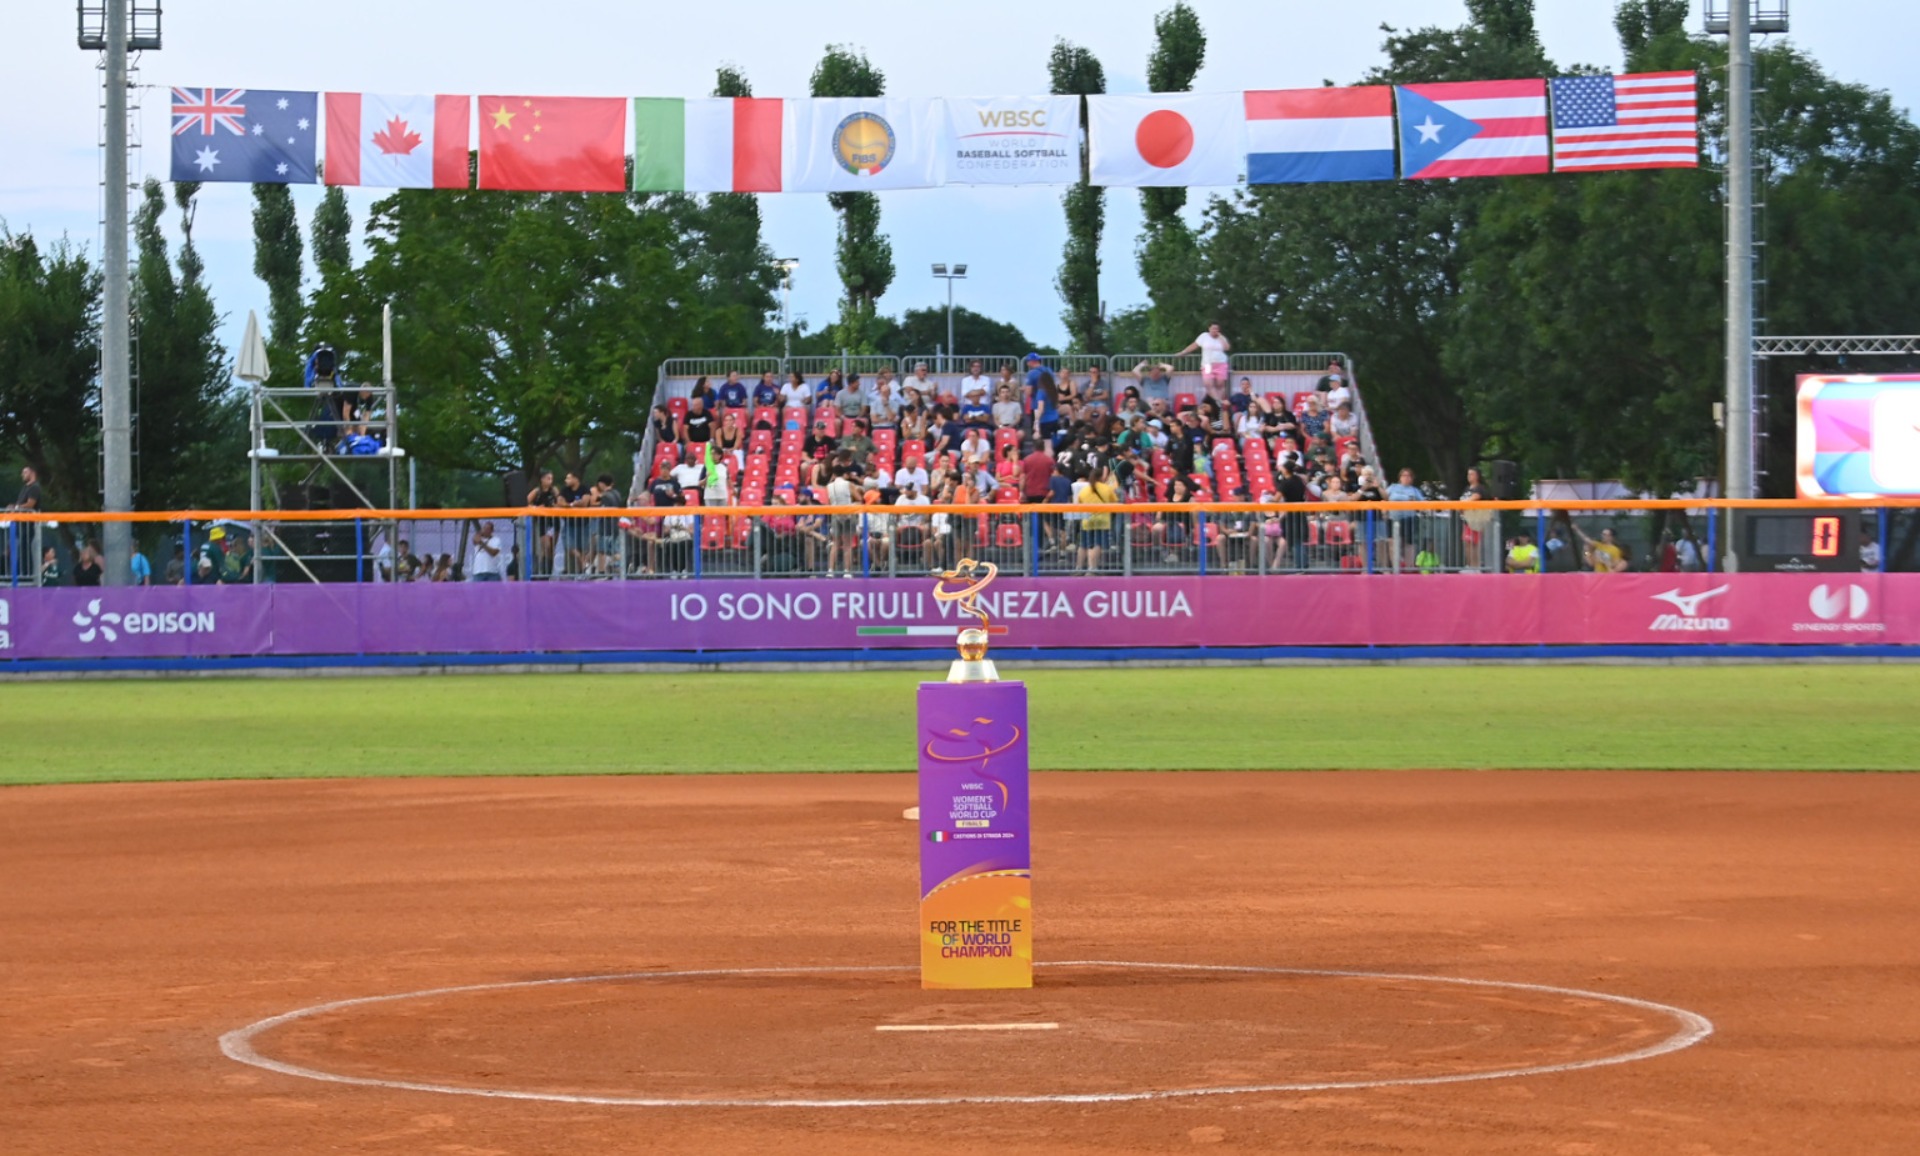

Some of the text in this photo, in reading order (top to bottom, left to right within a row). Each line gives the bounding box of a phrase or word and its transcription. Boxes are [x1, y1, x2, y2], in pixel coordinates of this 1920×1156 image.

[978, 110, 1046, 128] WBSC
[988, 138, 1036, 149] WORLD
[851, 153, 877, 164] FIBS
[956, 149, 1068, 159] BASEBALL SOFTBALL
[956, 160, 1068, 170] CONFEDERATION
[1812, 517, 1840, 557] 0
[671, 590, 1192, 621] IO SONO FRIULI VENEZIA GIULIA
[1792, 623, 1885, 631] SYNERGY SPORTS
[953, 803, 992, 811] SOFTBALL
[949, 811, 979, 819] WORLD
[930, 920, 1021, 933] FOR THE TITLE
[942, 933, 1011, 945] OF WORLD
[941, 945, 1012, 958] CHAMPION
